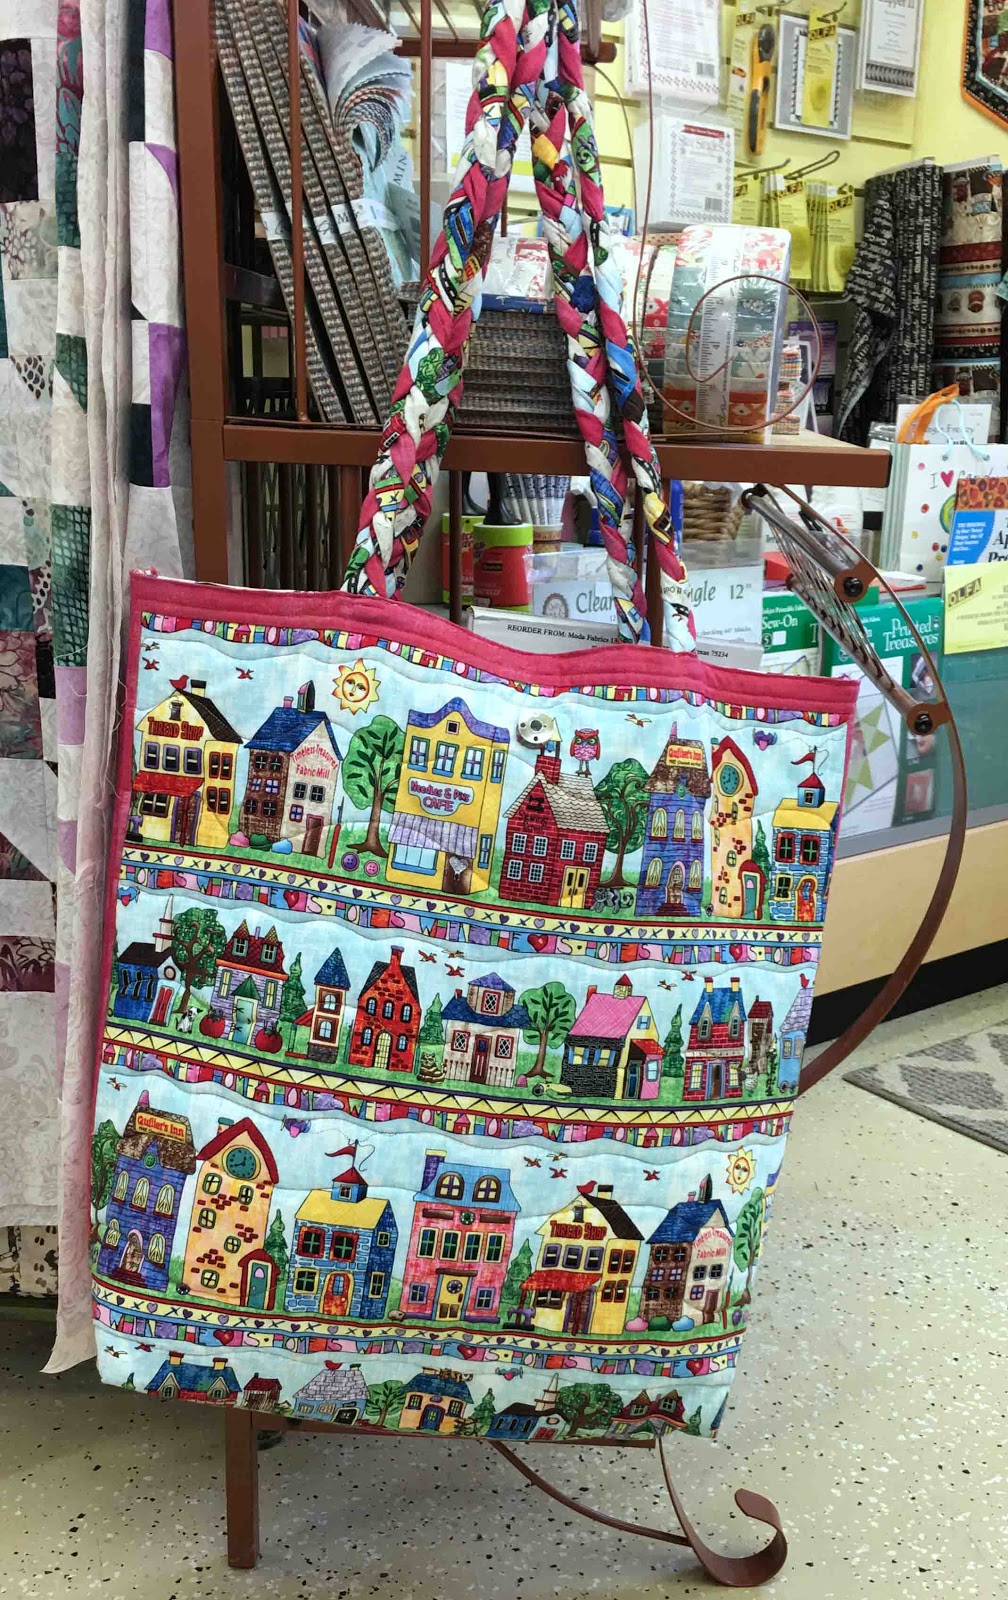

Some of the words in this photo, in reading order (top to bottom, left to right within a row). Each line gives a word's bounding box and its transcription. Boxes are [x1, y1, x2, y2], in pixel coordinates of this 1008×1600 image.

[809, 25, 836, 40] OLFA
[828, 194, 852, 213] OLFA
[948, 577, 983, 608] OLFA
[576, 591, 612, 613] Clear
[762, 614, 798, 630] Sew-On
[508, 624, 542, 635] REORDER
[544, 629, 566, 638] FROM:
[883, 633, 938, 652] Treasres
[296, 764, 316, 776] Fabric
[316, 768, 330, 779] Mill
[423, 796, 454, 812] CAFE
[170, 1124, 184, 1138] Inn
